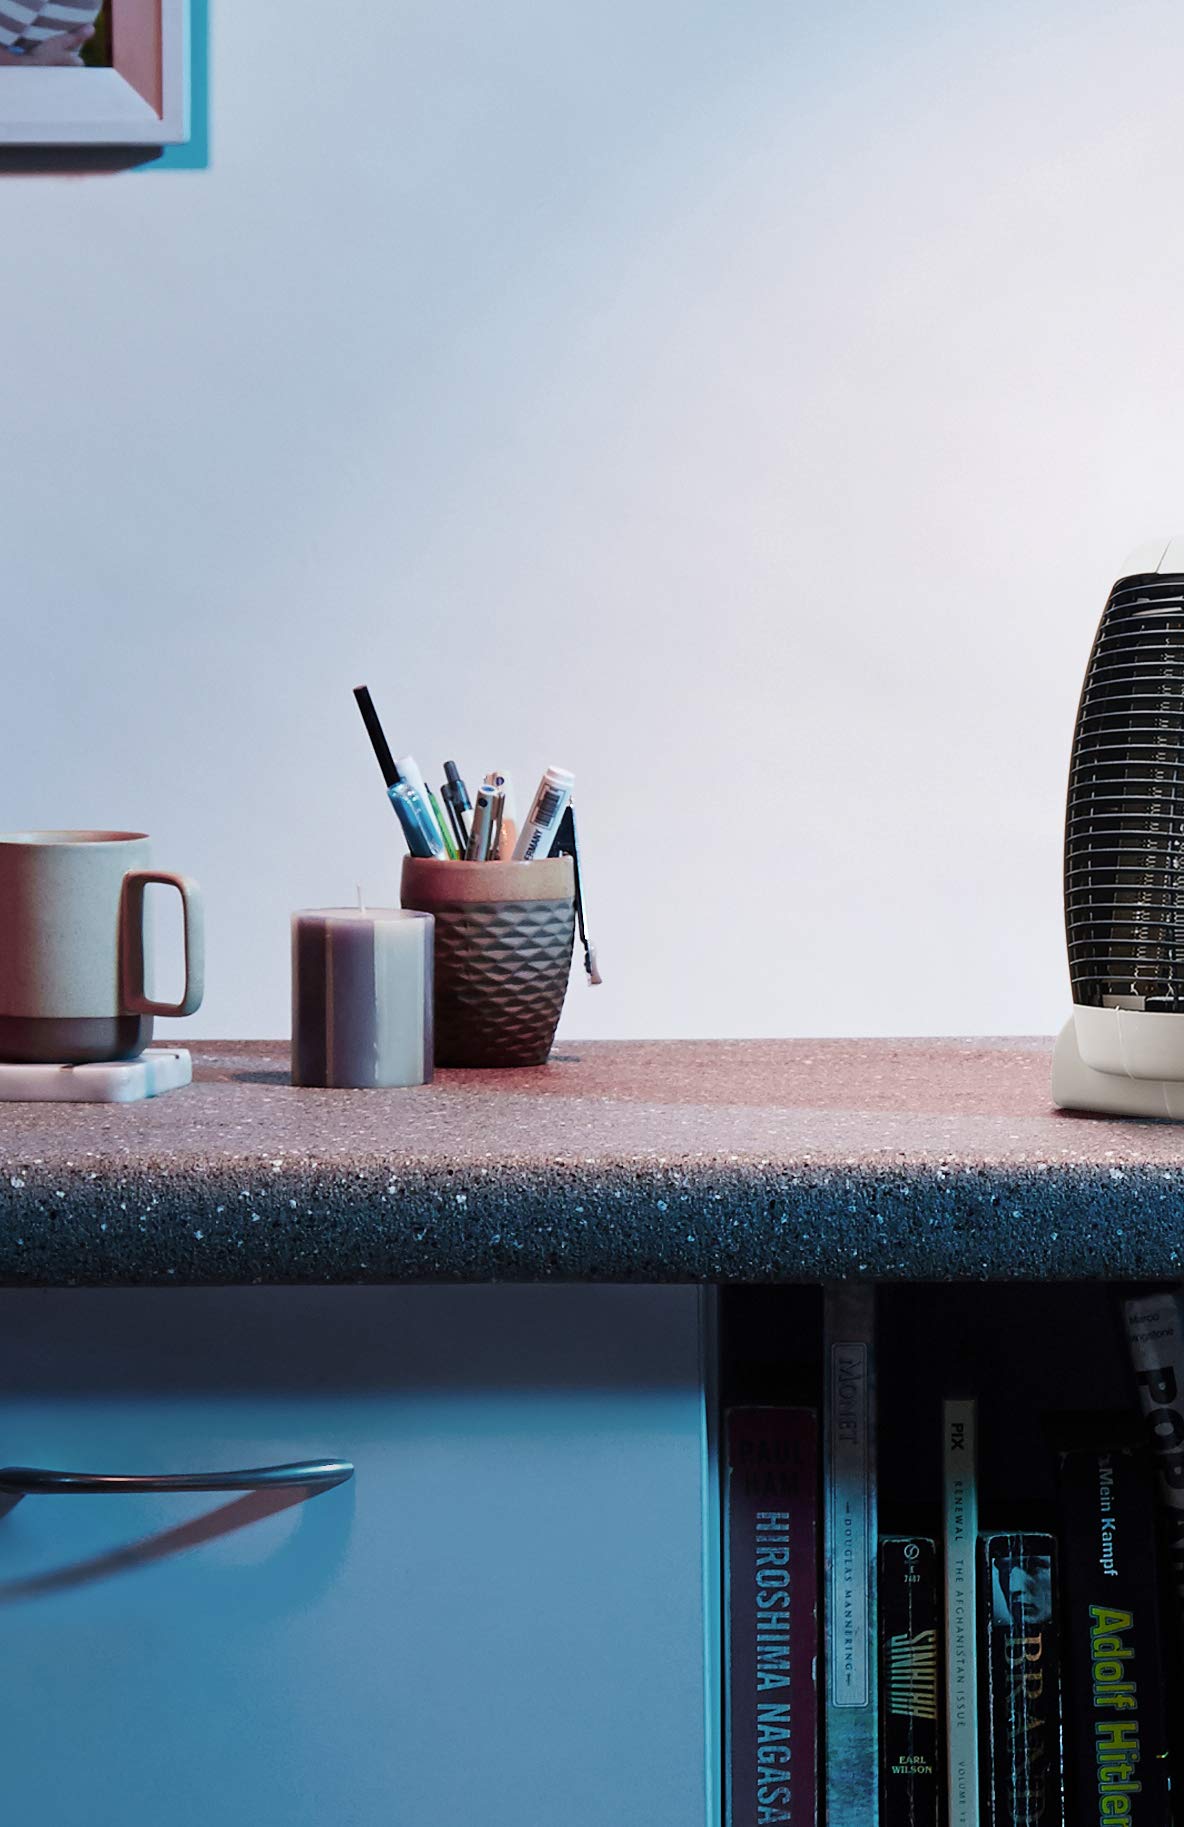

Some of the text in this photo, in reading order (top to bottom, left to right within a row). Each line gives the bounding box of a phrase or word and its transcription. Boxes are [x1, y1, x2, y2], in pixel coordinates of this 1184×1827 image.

[524, 829, 543, 860] ERMANY
[952, 1423, 964, 1450] PIX
[953, 1480, 963, 1541] RENEWAL
[1098, 1467, 1119, 1577] Mein Kampf
[955, 1560, 964, 1582] THE
[845, 1518, 854, 1672] DOUGLAS MANNERING
[955, 1592, 967, 1684] AFGHANISTAN
[755, 1511, 791, 1825] HIROSHIMA NAGASA
[956, 1690, 967, 1728] ISSUE
[1089, 1604, 1142, 1827] Adolf Hitler
[892, 1765, 933, 1775] WILSON
[899, 1755, 927, 1765] EARL
[958, 1761, 967, 1805] VOLUME
